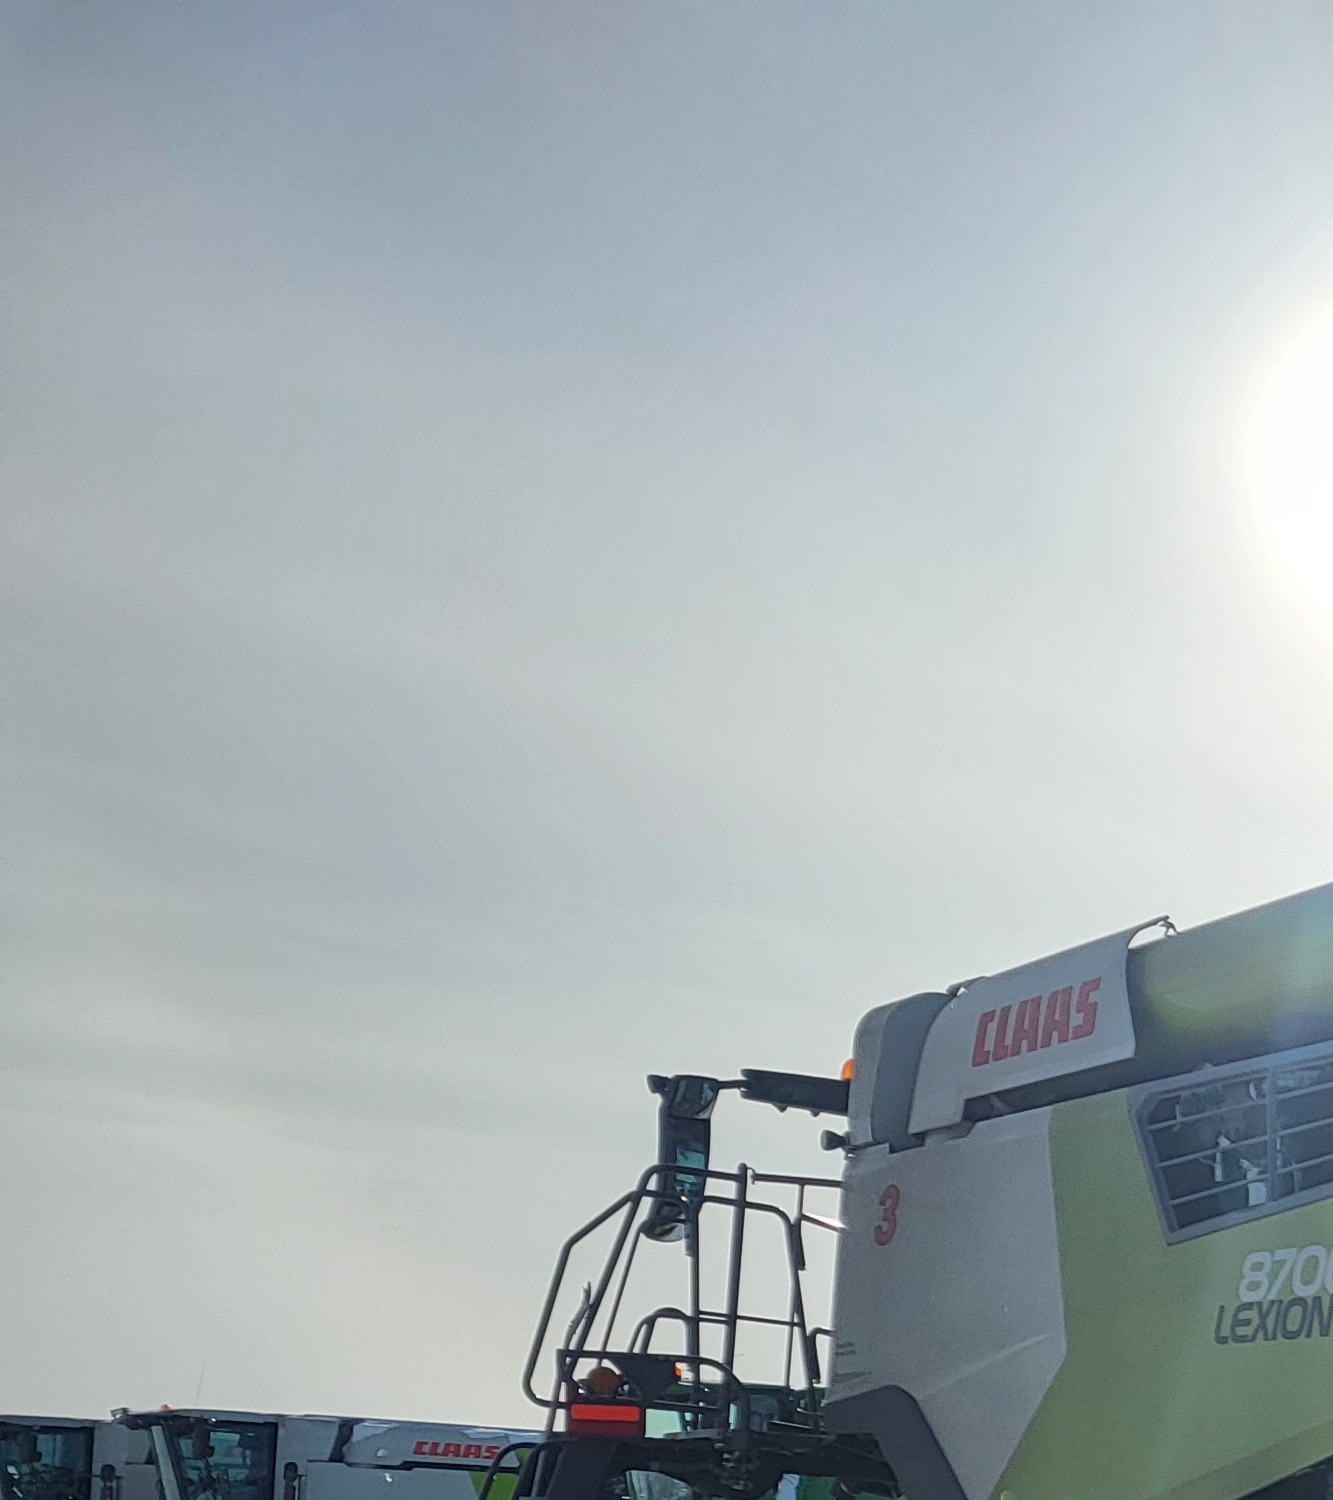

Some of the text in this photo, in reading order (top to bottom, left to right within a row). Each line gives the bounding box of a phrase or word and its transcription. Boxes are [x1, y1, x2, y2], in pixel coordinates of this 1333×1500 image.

[972, 977, 1102, 1067] CLAAS
[873, 1183, 900, 1246] 3
[412, 1441, 500, 1459] CLAAS
